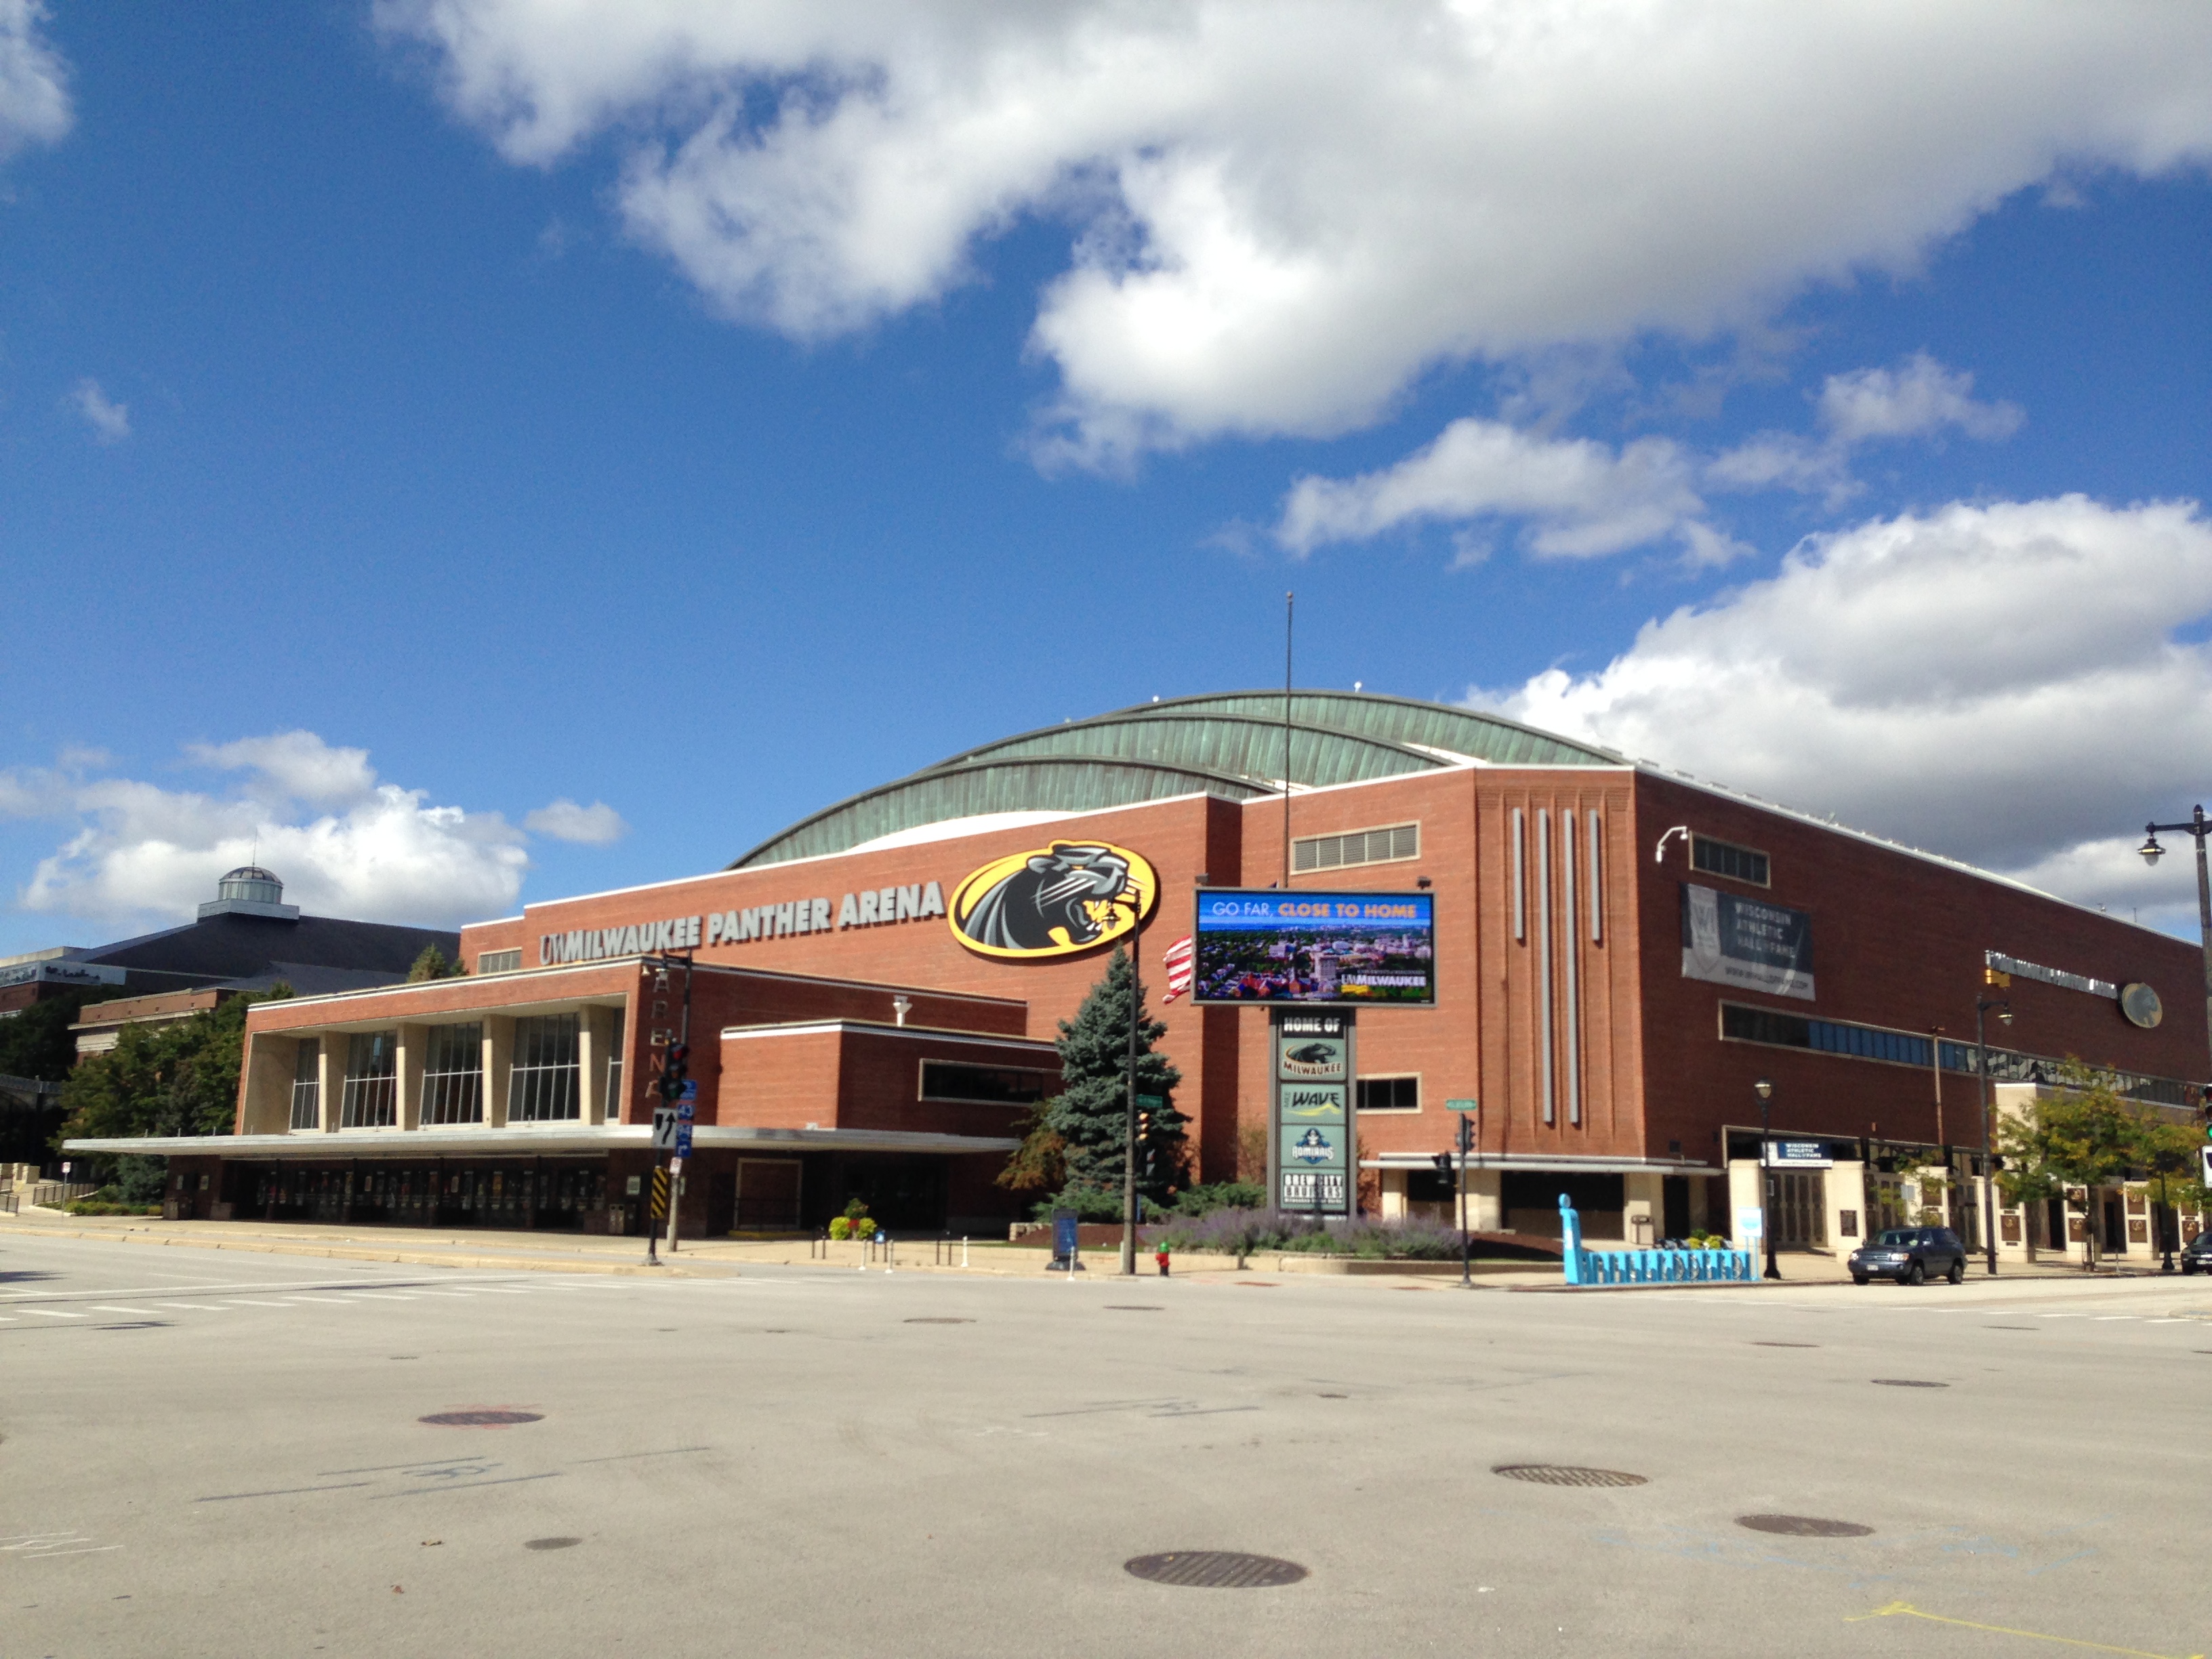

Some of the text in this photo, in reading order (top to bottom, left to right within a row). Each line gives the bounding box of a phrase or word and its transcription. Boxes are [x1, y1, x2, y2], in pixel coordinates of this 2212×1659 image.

[707, 898, 833, 945] PANTHER
[837, 881, 946, 929] ARENA
[1212, 902, 1417, 919] GO FAR, CLOSE TO HOME
[1735, 901, 1791, 926] WISCONSIN
[1737, 918, 1783, 939] ATHLETIC
[1284, 1017, 1340, 1032] HOME OF
[1282, 1061, 1343, 1076] MILWAUKEE
[1292, 1091, 1340, 1108] WAVE
[1285, 1174, 1342, 1186] BREW CITY
